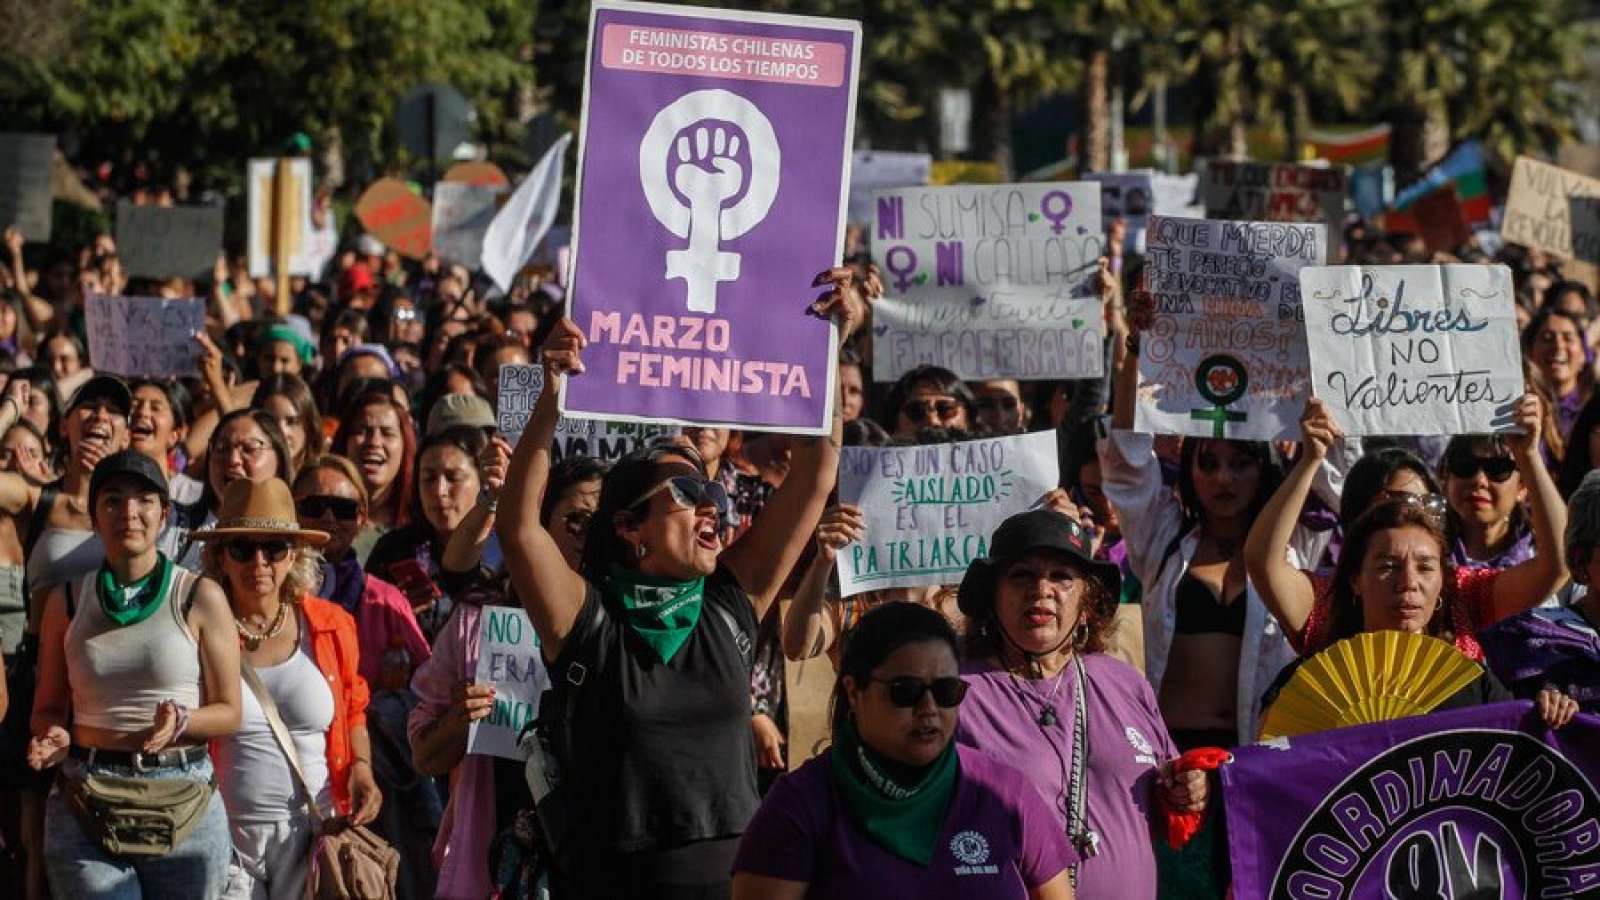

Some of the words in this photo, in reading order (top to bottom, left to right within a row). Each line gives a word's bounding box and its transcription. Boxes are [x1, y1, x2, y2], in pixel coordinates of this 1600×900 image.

[629, 29, 728, 53] FEMINISTAS
[732, 38, 815, 60] CHILENAS
[622, 49, 644, 65] DE
[648, 51, 707, 70] TODOS
[710, 56, 741, 73] LOS
[745, 59, 820, 80] TIEMPOS
[877, 196, 904, 240] NI
[918, 190, 1026, 240] SUMISA
[1221, 222, 1318, 261] MIERDA
[936, 241, 965, 287] NI
[974, 236, 1100, 285] CALLADA
[1331, 273, 1489, 336] Libres
[590, 311, 730, 353] MARZO
[1391, 338, 1440, 366] NO
[501, 366, 543, 388] POR
[616, 351, 812, 398] FEMINISTA
[1327, 369, 1513, 410] Valientes
[842, 447, 872, 476] NO
[881, 451, 904, 479] ES
[915, 448, 940, 476] UN
[950, 440, 1004, 474] CASO
[895, 505, 918, 531] ES
[943, 504, 969, 529] EL
[488, 611, 522, 645] NO
[489, 652, 538, 686] ERA
[480, 699, 535, 732] UNCA
